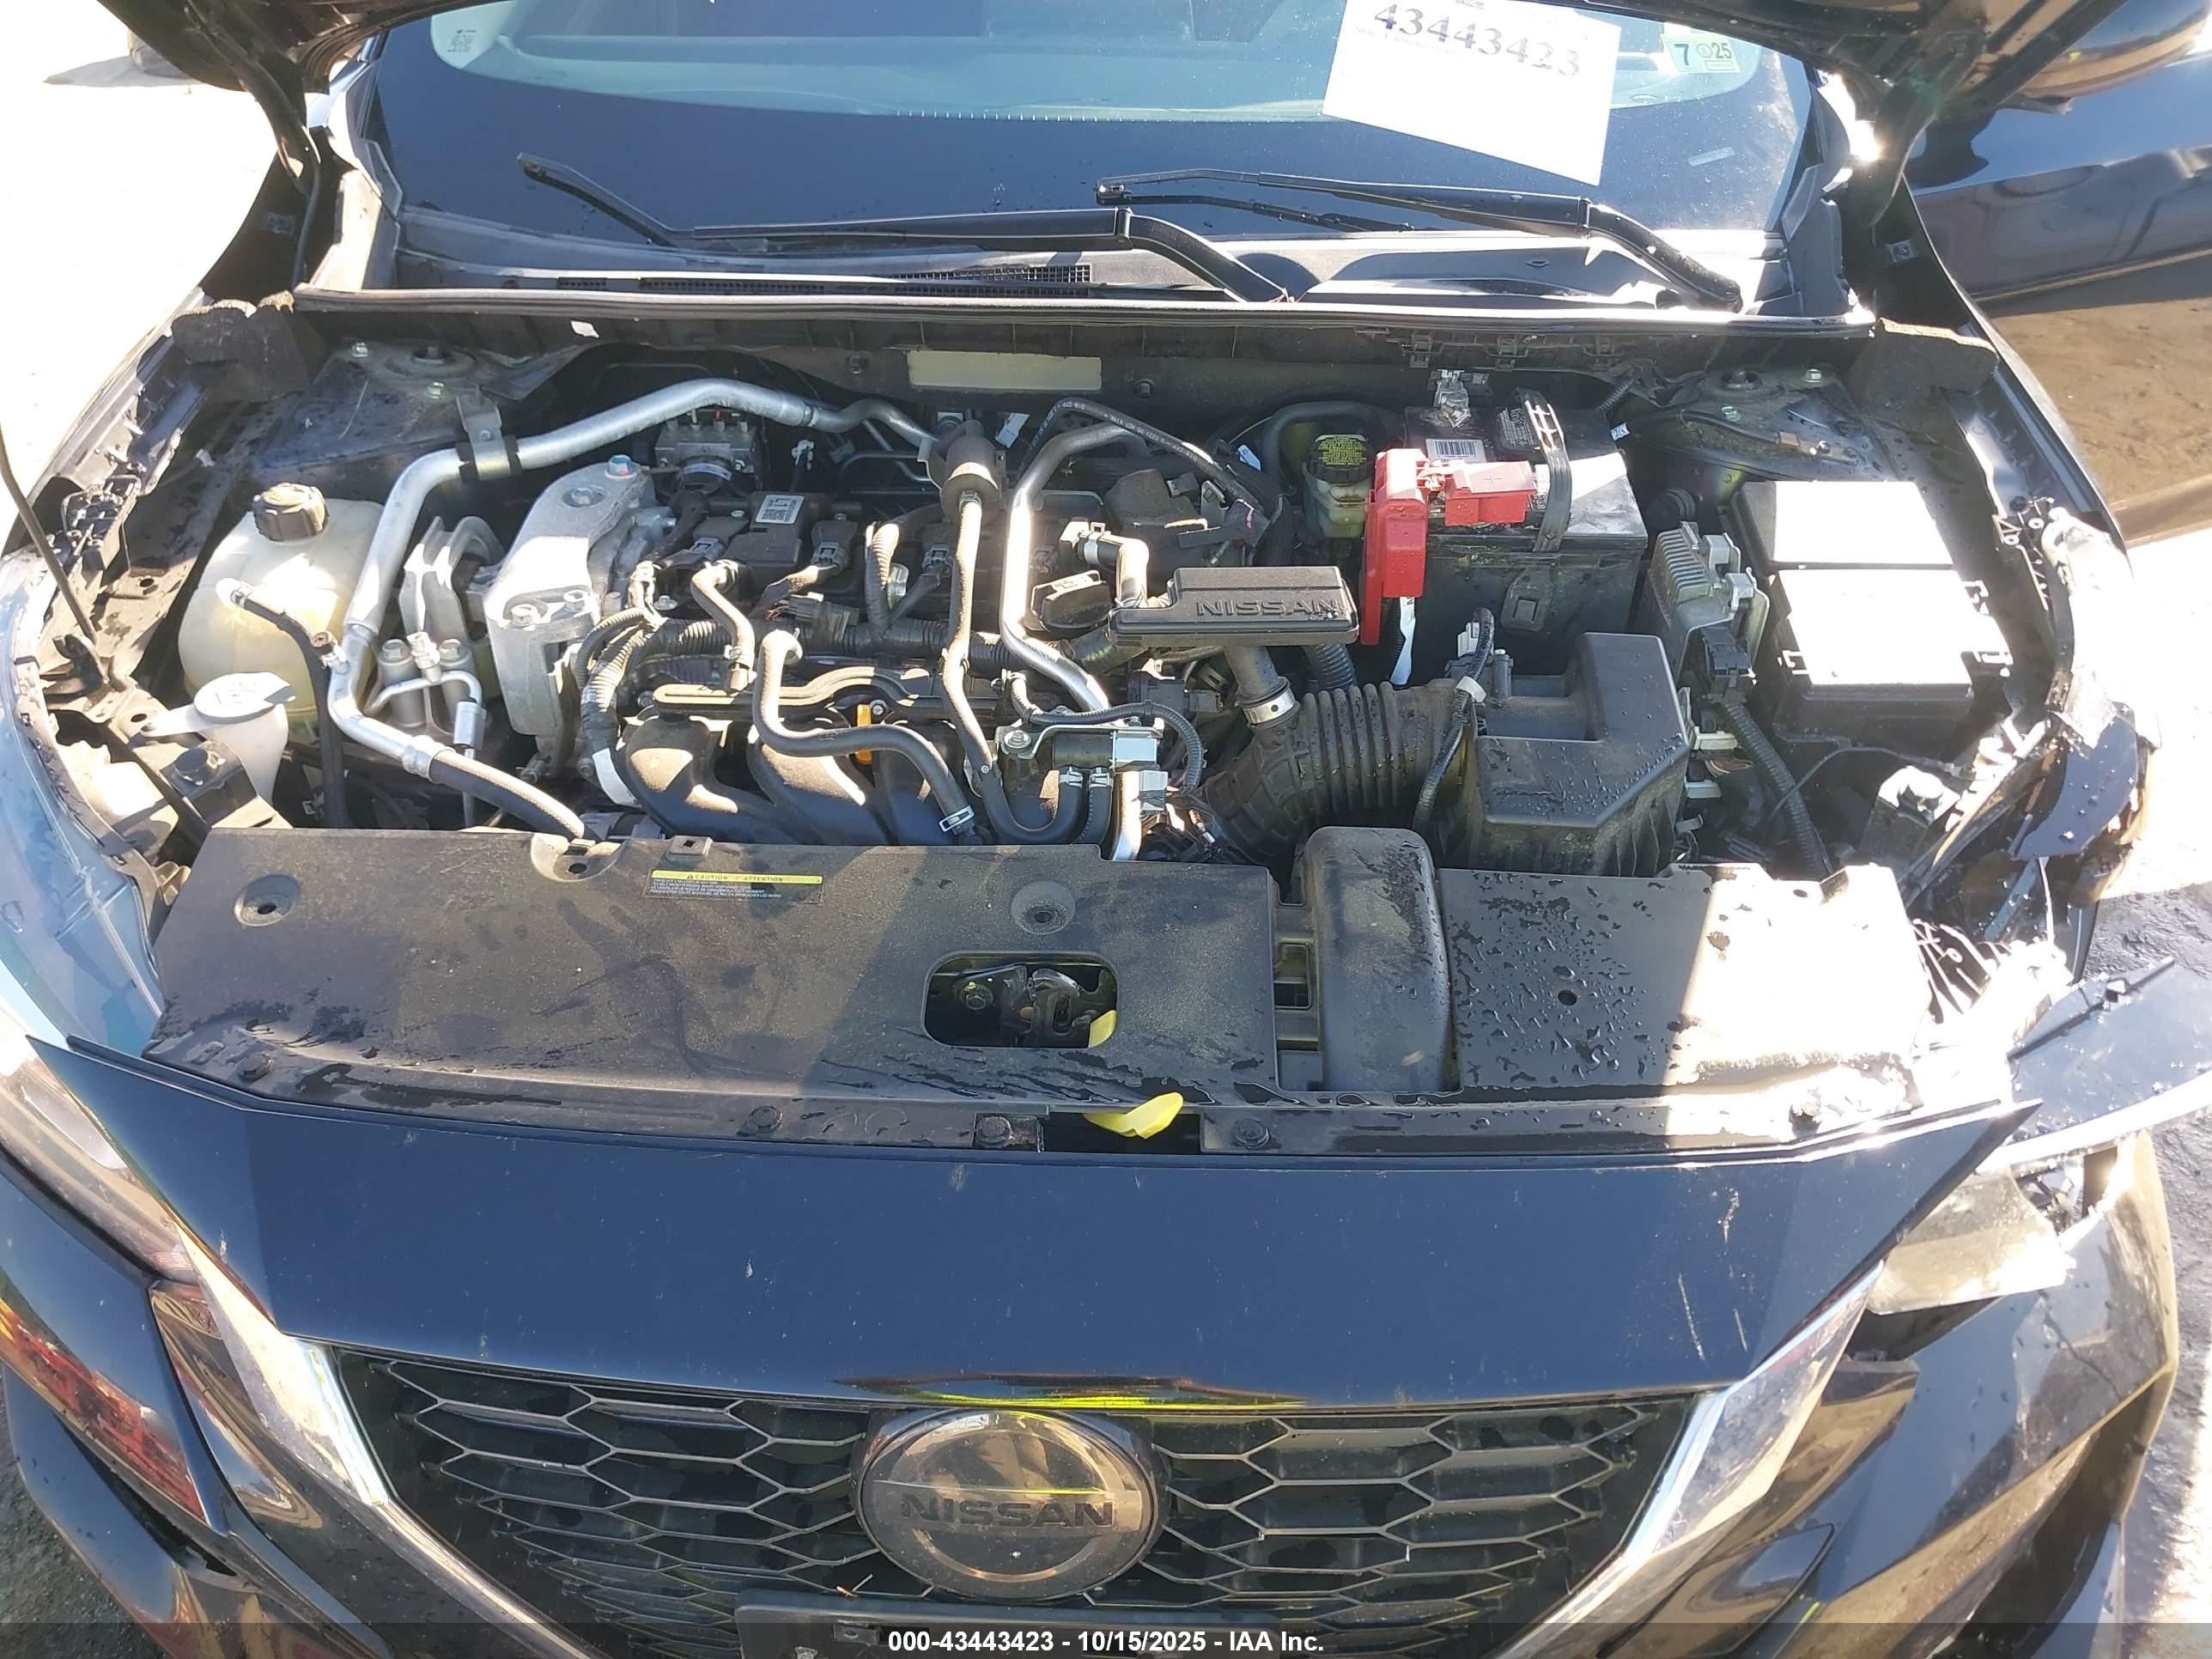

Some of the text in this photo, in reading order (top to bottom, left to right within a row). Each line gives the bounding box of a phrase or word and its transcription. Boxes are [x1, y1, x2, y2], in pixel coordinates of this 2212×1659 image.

[1374, 3, 1580, 76] 43443423
[1674, 43, 1690, 66] 7
[1711, 42, 1733, 59] 25
[1196, 599, 1344, 617] NISSAN
[901, 1495, 1114, 1528] NISSAN
